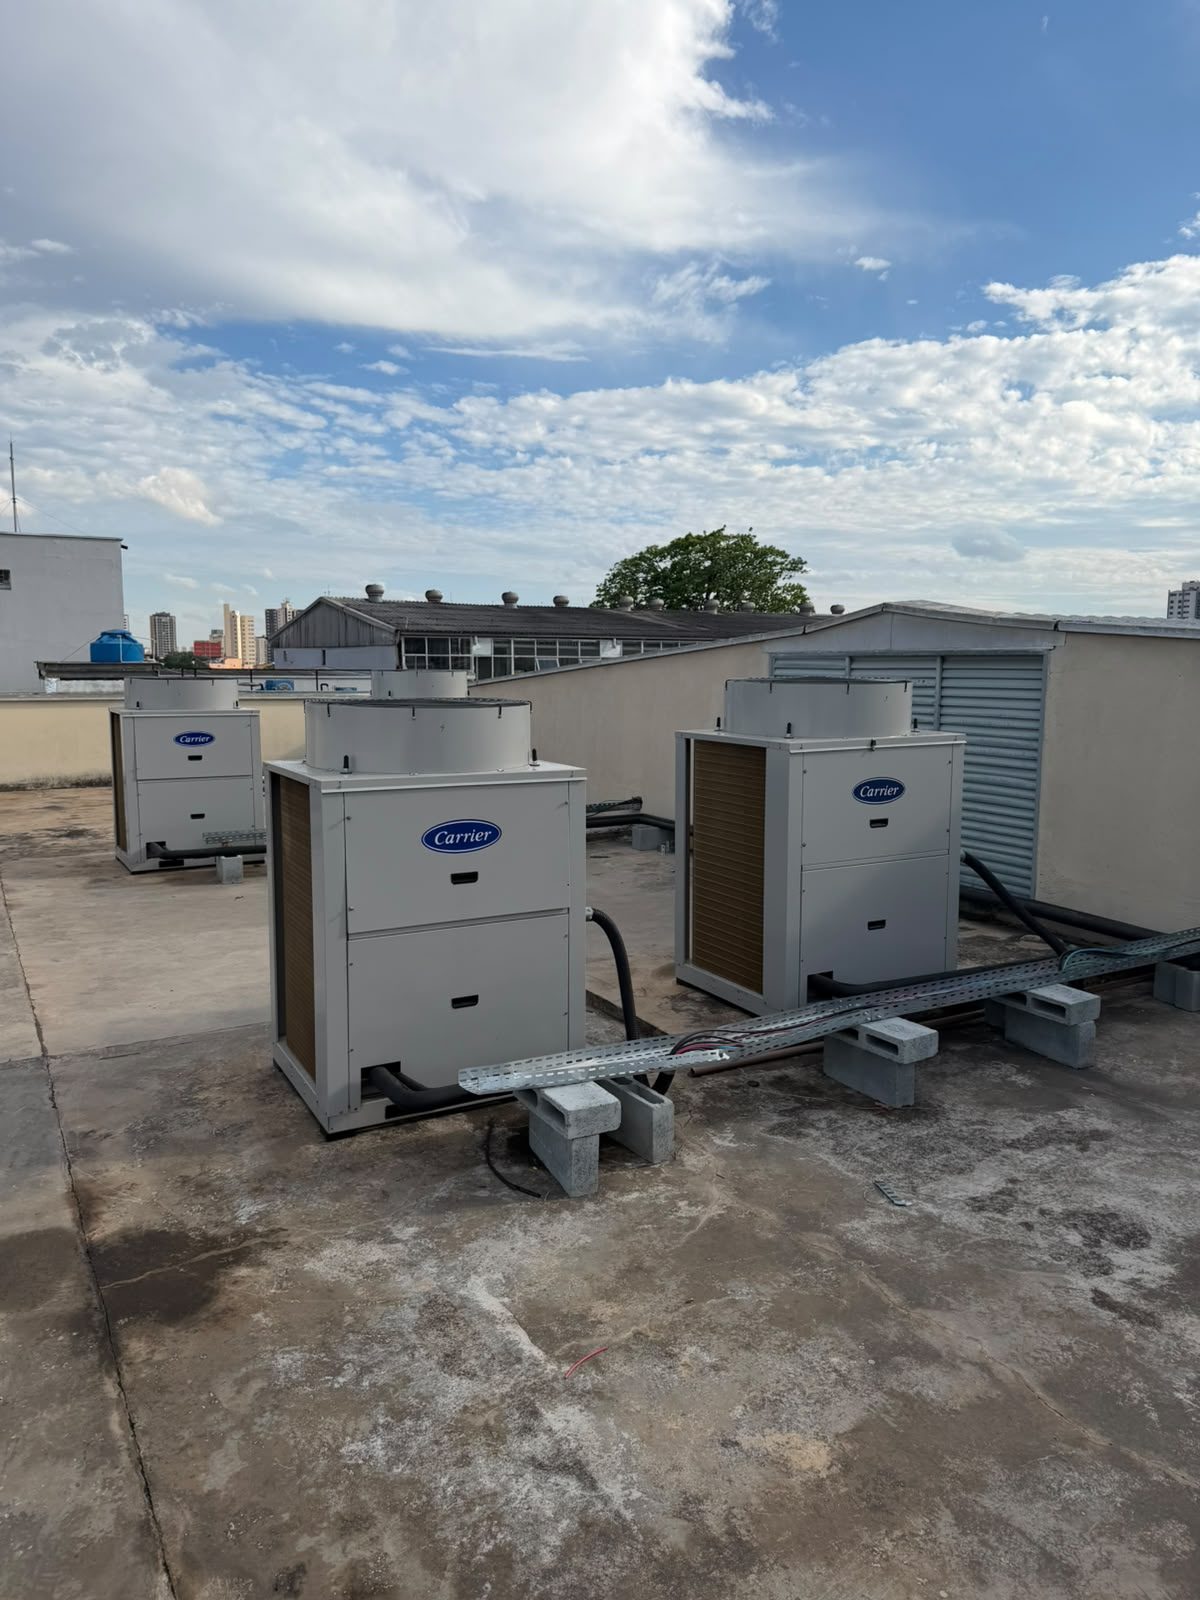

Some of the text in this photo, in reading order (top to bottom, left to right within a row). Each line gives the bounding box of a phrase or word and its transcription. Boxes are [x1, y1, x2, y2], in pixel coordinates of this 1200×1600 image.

[179, 735, 210, 743] Carrier
[860, 785, 899, 798] Carrier
[434, 829, 492, 846] Carrier
